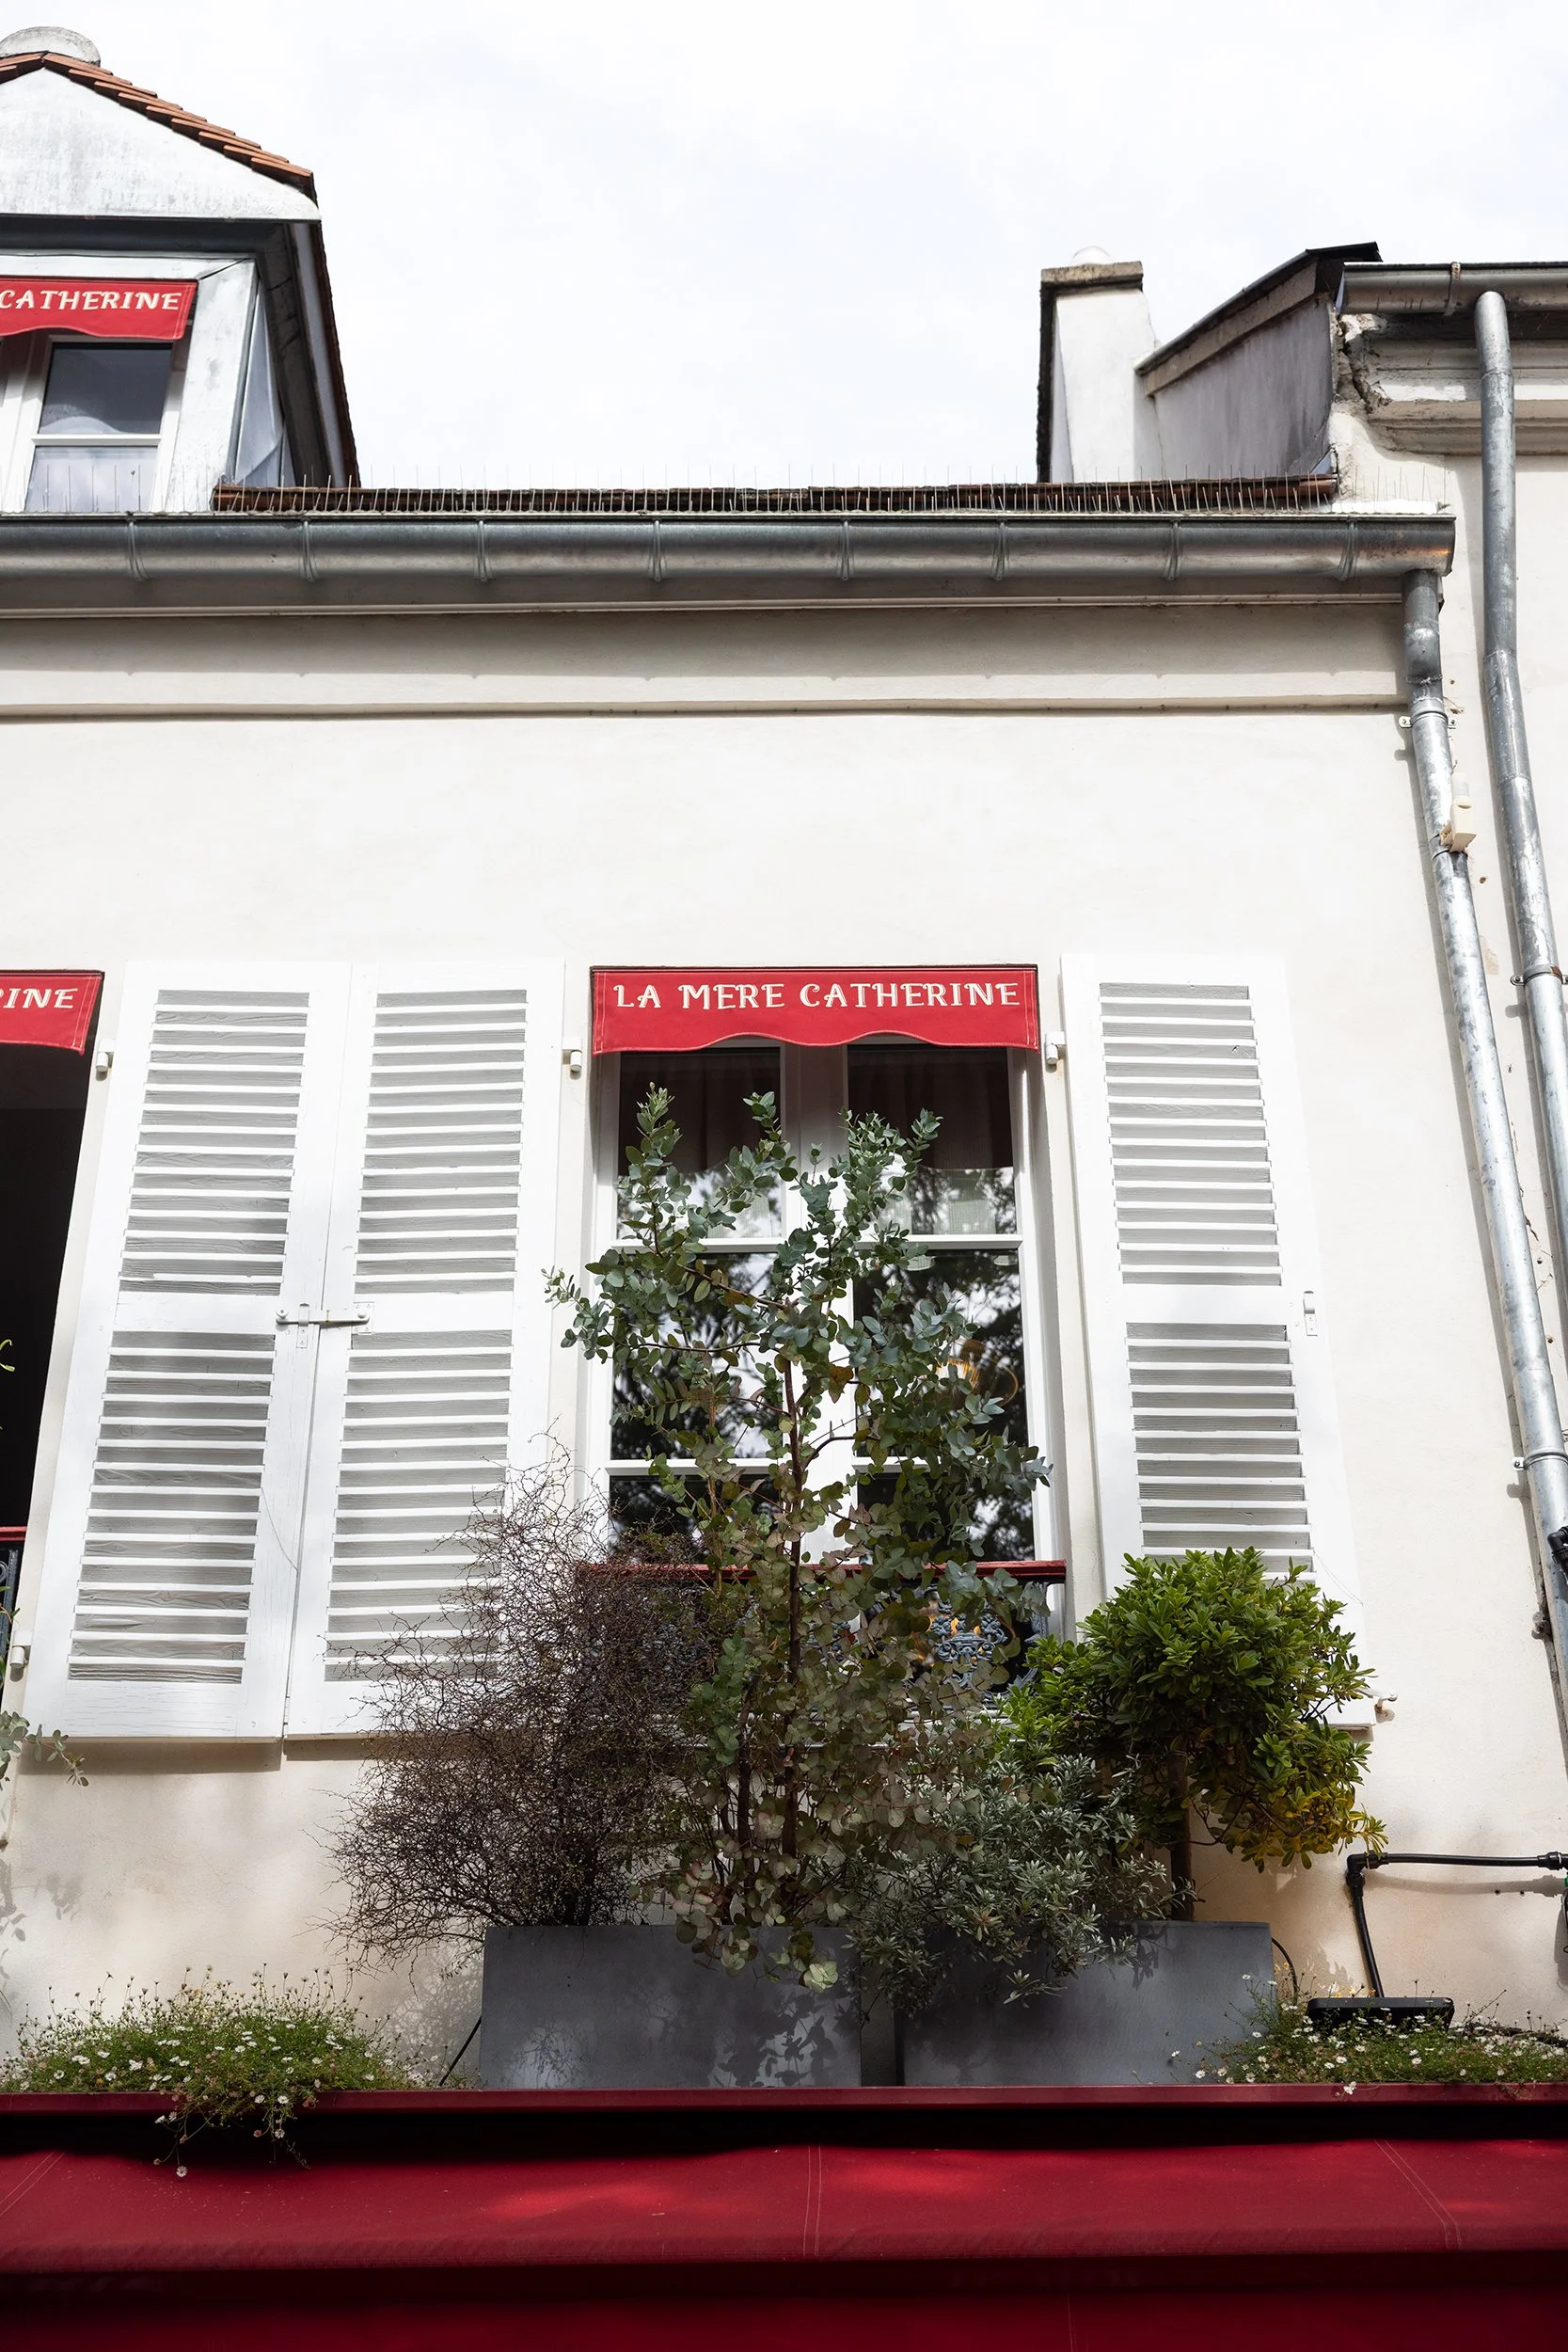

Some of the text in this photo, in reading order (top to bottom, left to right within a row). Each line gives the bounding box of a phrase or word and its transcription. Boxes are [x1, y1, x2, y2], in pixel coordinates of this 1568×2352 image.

[0, 289, 182, 310] CATHERINE
[0, 988, 78, 1009] INE
[612, 981, 1021, 1009] LA MERE CATHERINE
